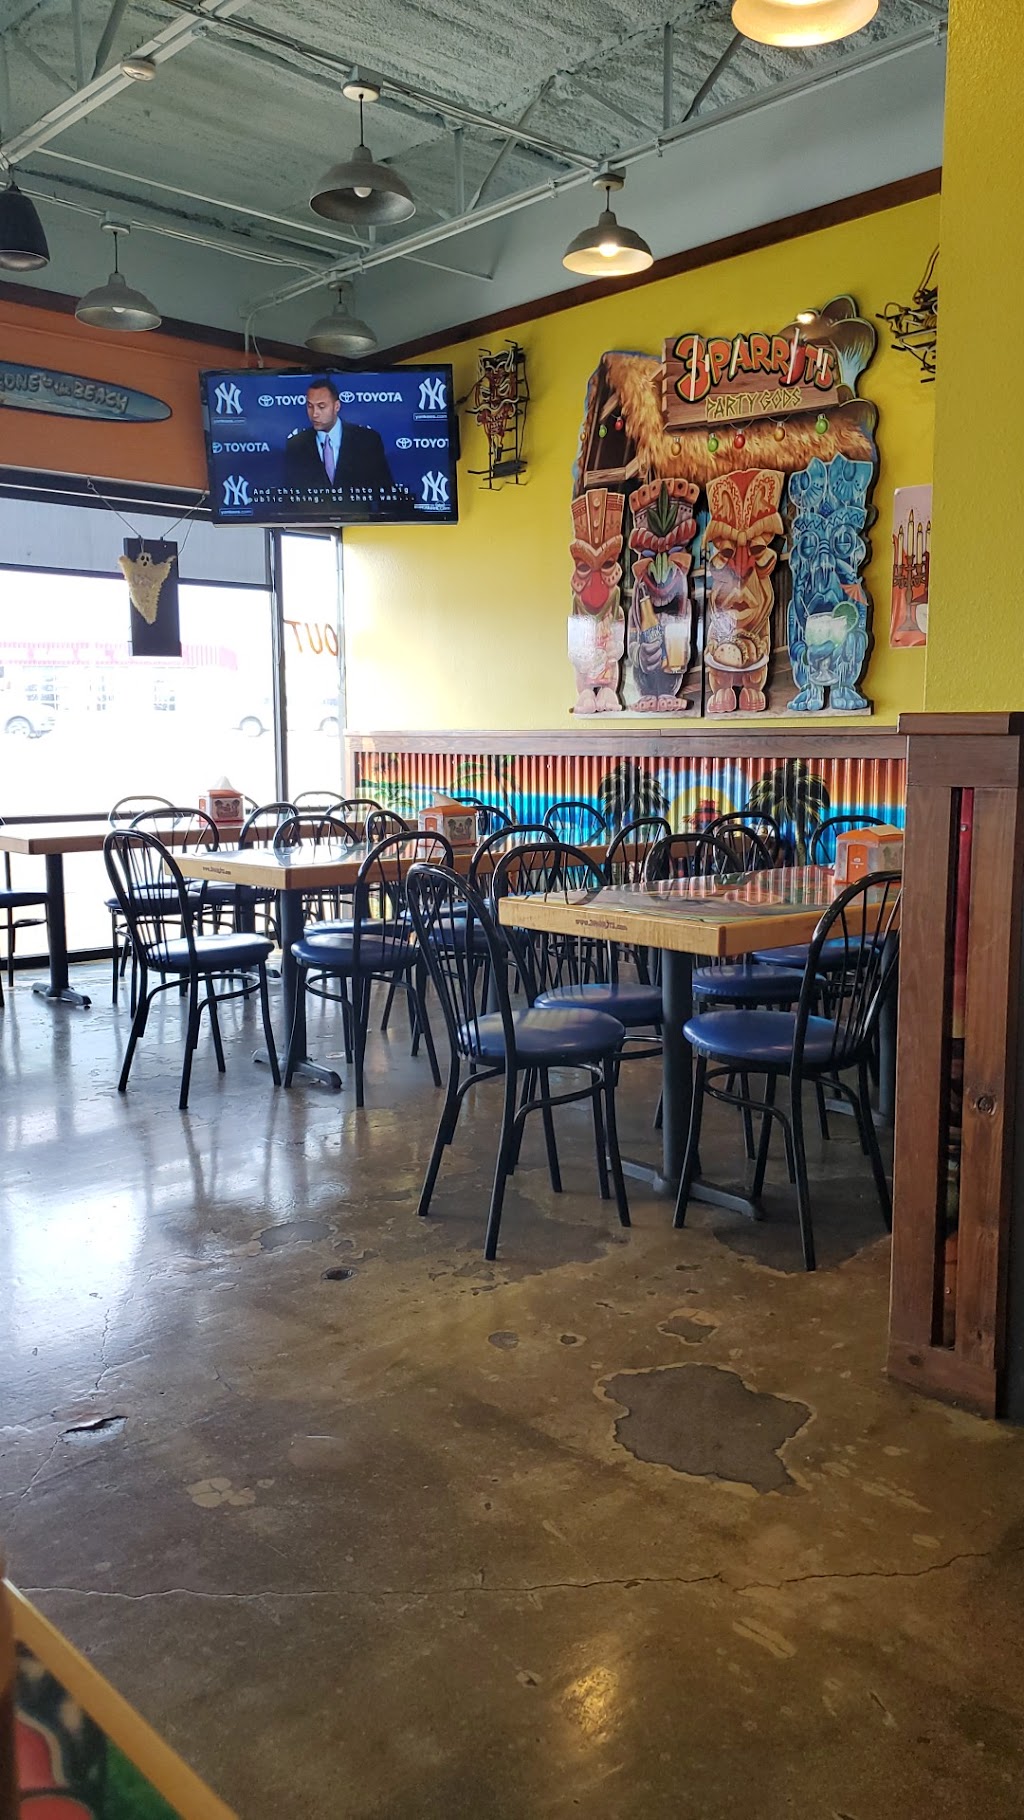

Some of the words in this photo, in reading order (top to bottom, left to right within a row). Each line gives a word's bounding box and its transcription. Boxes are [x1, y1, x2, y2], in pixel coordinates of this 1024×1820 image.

[0, 373, 40, 392] ONE
[73, 381, 129, 414] BEACH
[356, 392, 403, 402] TOYOTA
[706, 394, 757, 418] PARTY
[760, 388, 802, 410] GODS
[223, 442, 270, 452] TOYOTA
[307, 487, 343, 495] turned
[391, 486, 409, 494] big
